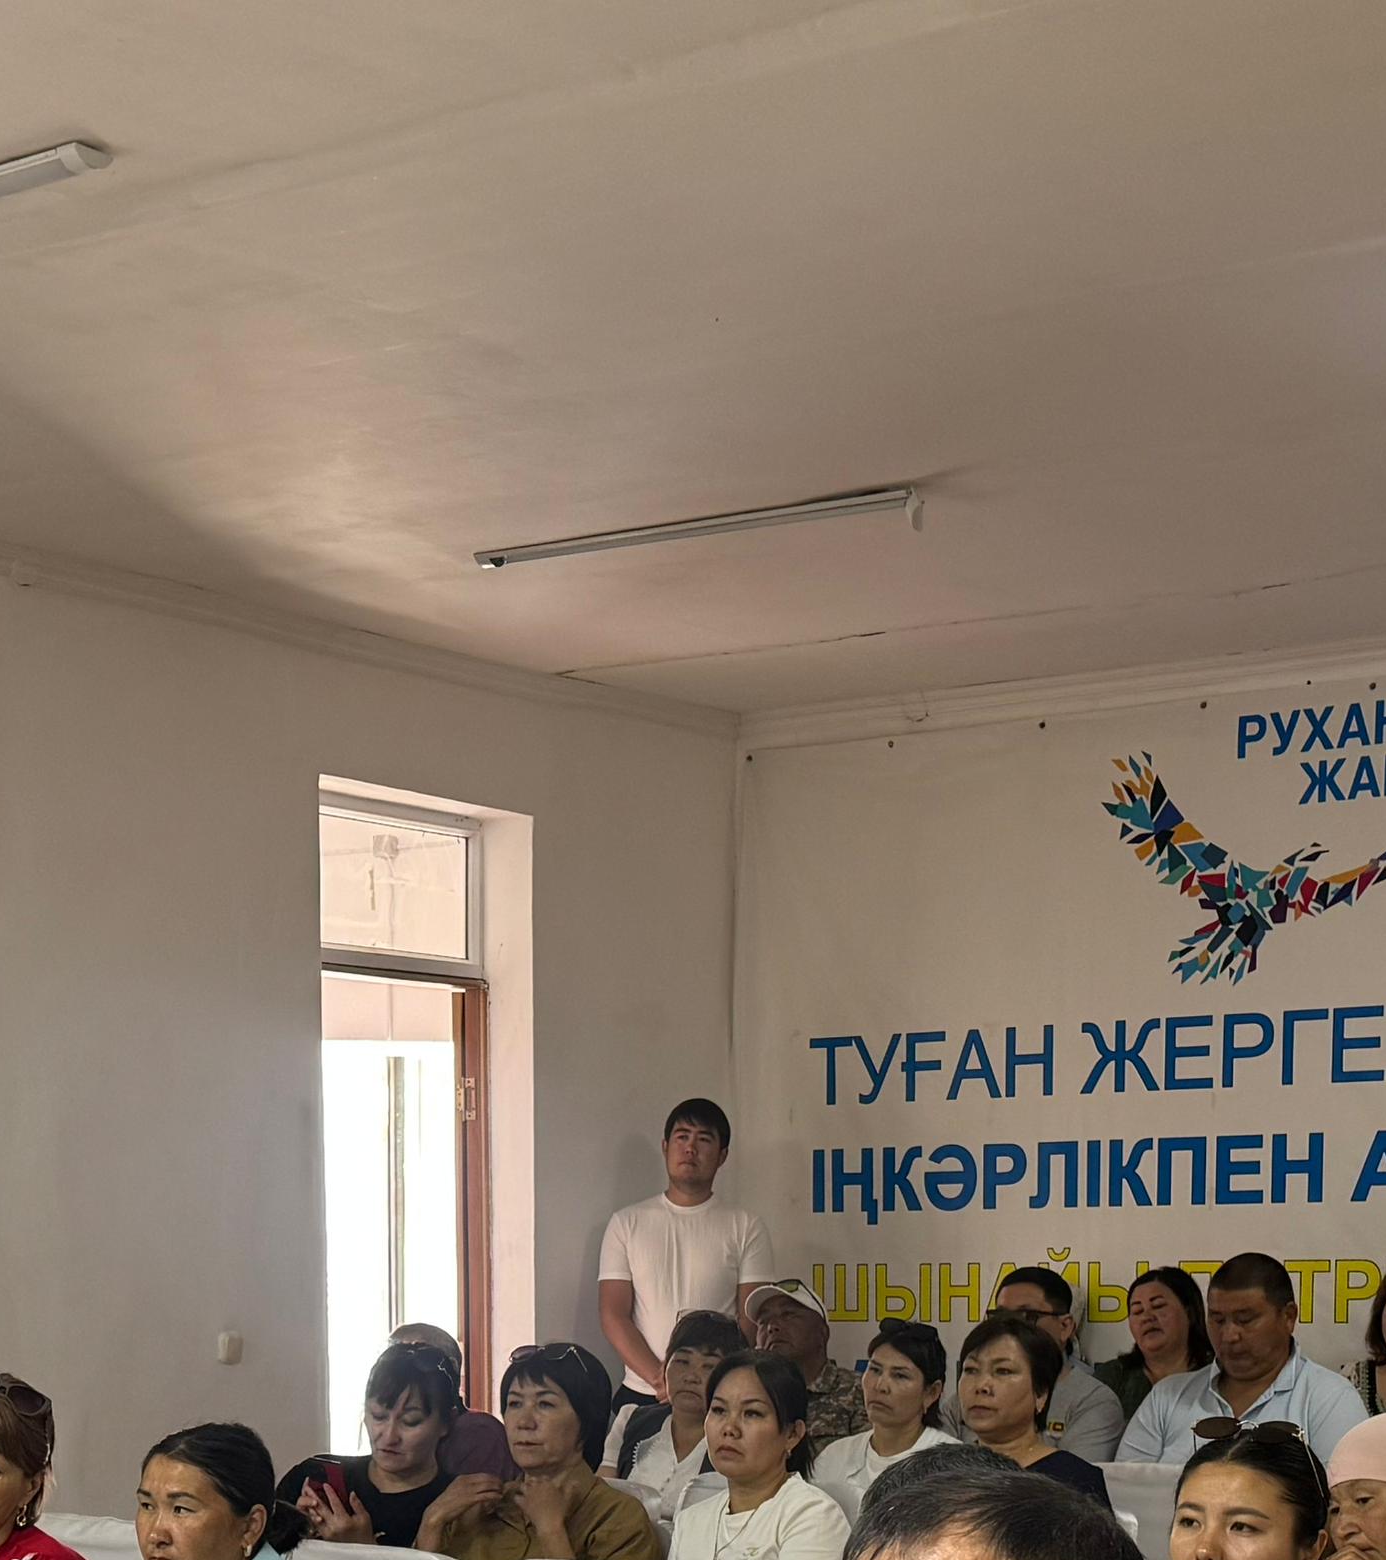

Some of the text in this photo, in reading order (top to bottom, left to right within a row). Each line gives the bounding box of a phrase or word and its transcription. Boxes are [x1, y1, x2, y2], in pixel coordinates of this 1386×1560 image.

[809, 1026, 1055, 1106] ТУҒАН
[1081, 1005, 1386, 1095] ЖЕРГЕ
[812, 1132, 1325, 1226] ІҢКӘРЛІКПЕН
